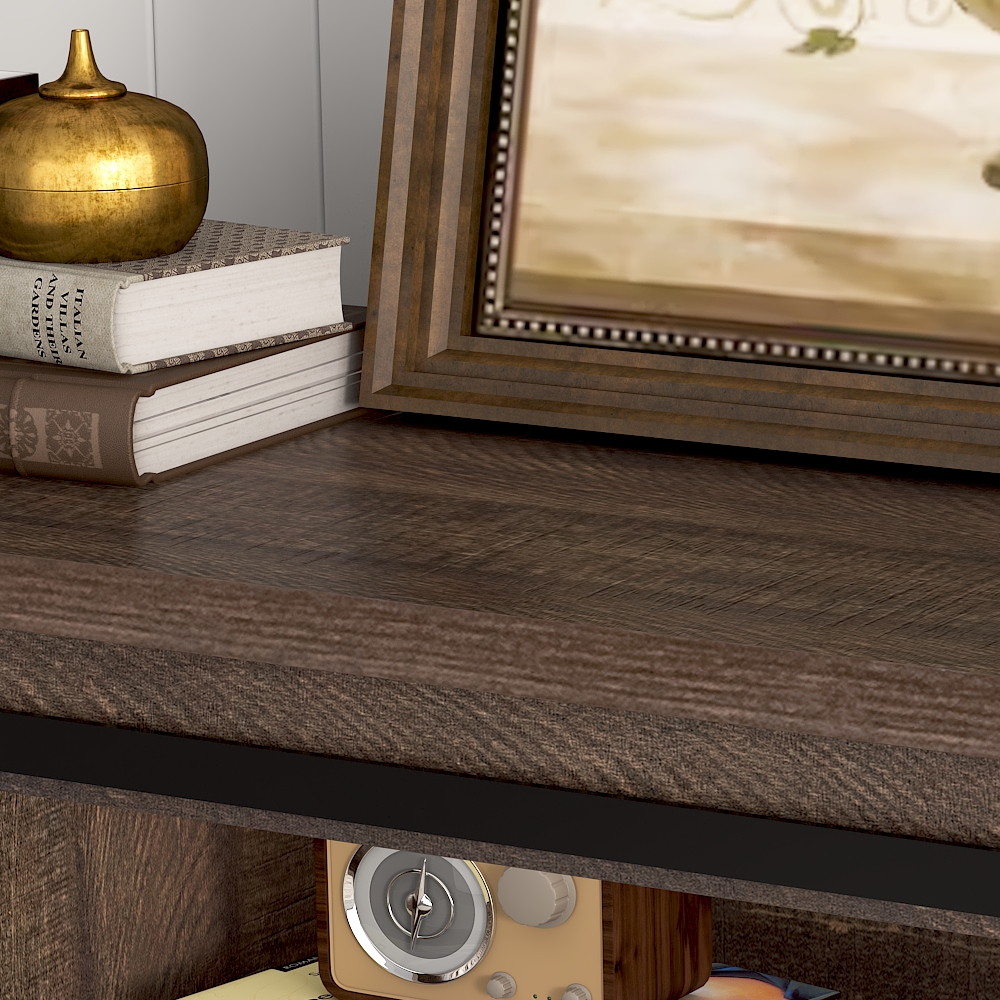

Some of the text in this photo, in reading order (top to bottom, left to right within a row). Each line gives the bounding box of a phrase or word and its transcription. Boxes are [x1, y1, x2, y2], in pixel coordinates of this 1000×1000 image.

[32, 277, 46, 358] GARDENS
[46, 273, 62, 365] AND THEIR
[60, 291, 71, 354] VILLAS
[74, 288, 87, 360] ITALIAN
